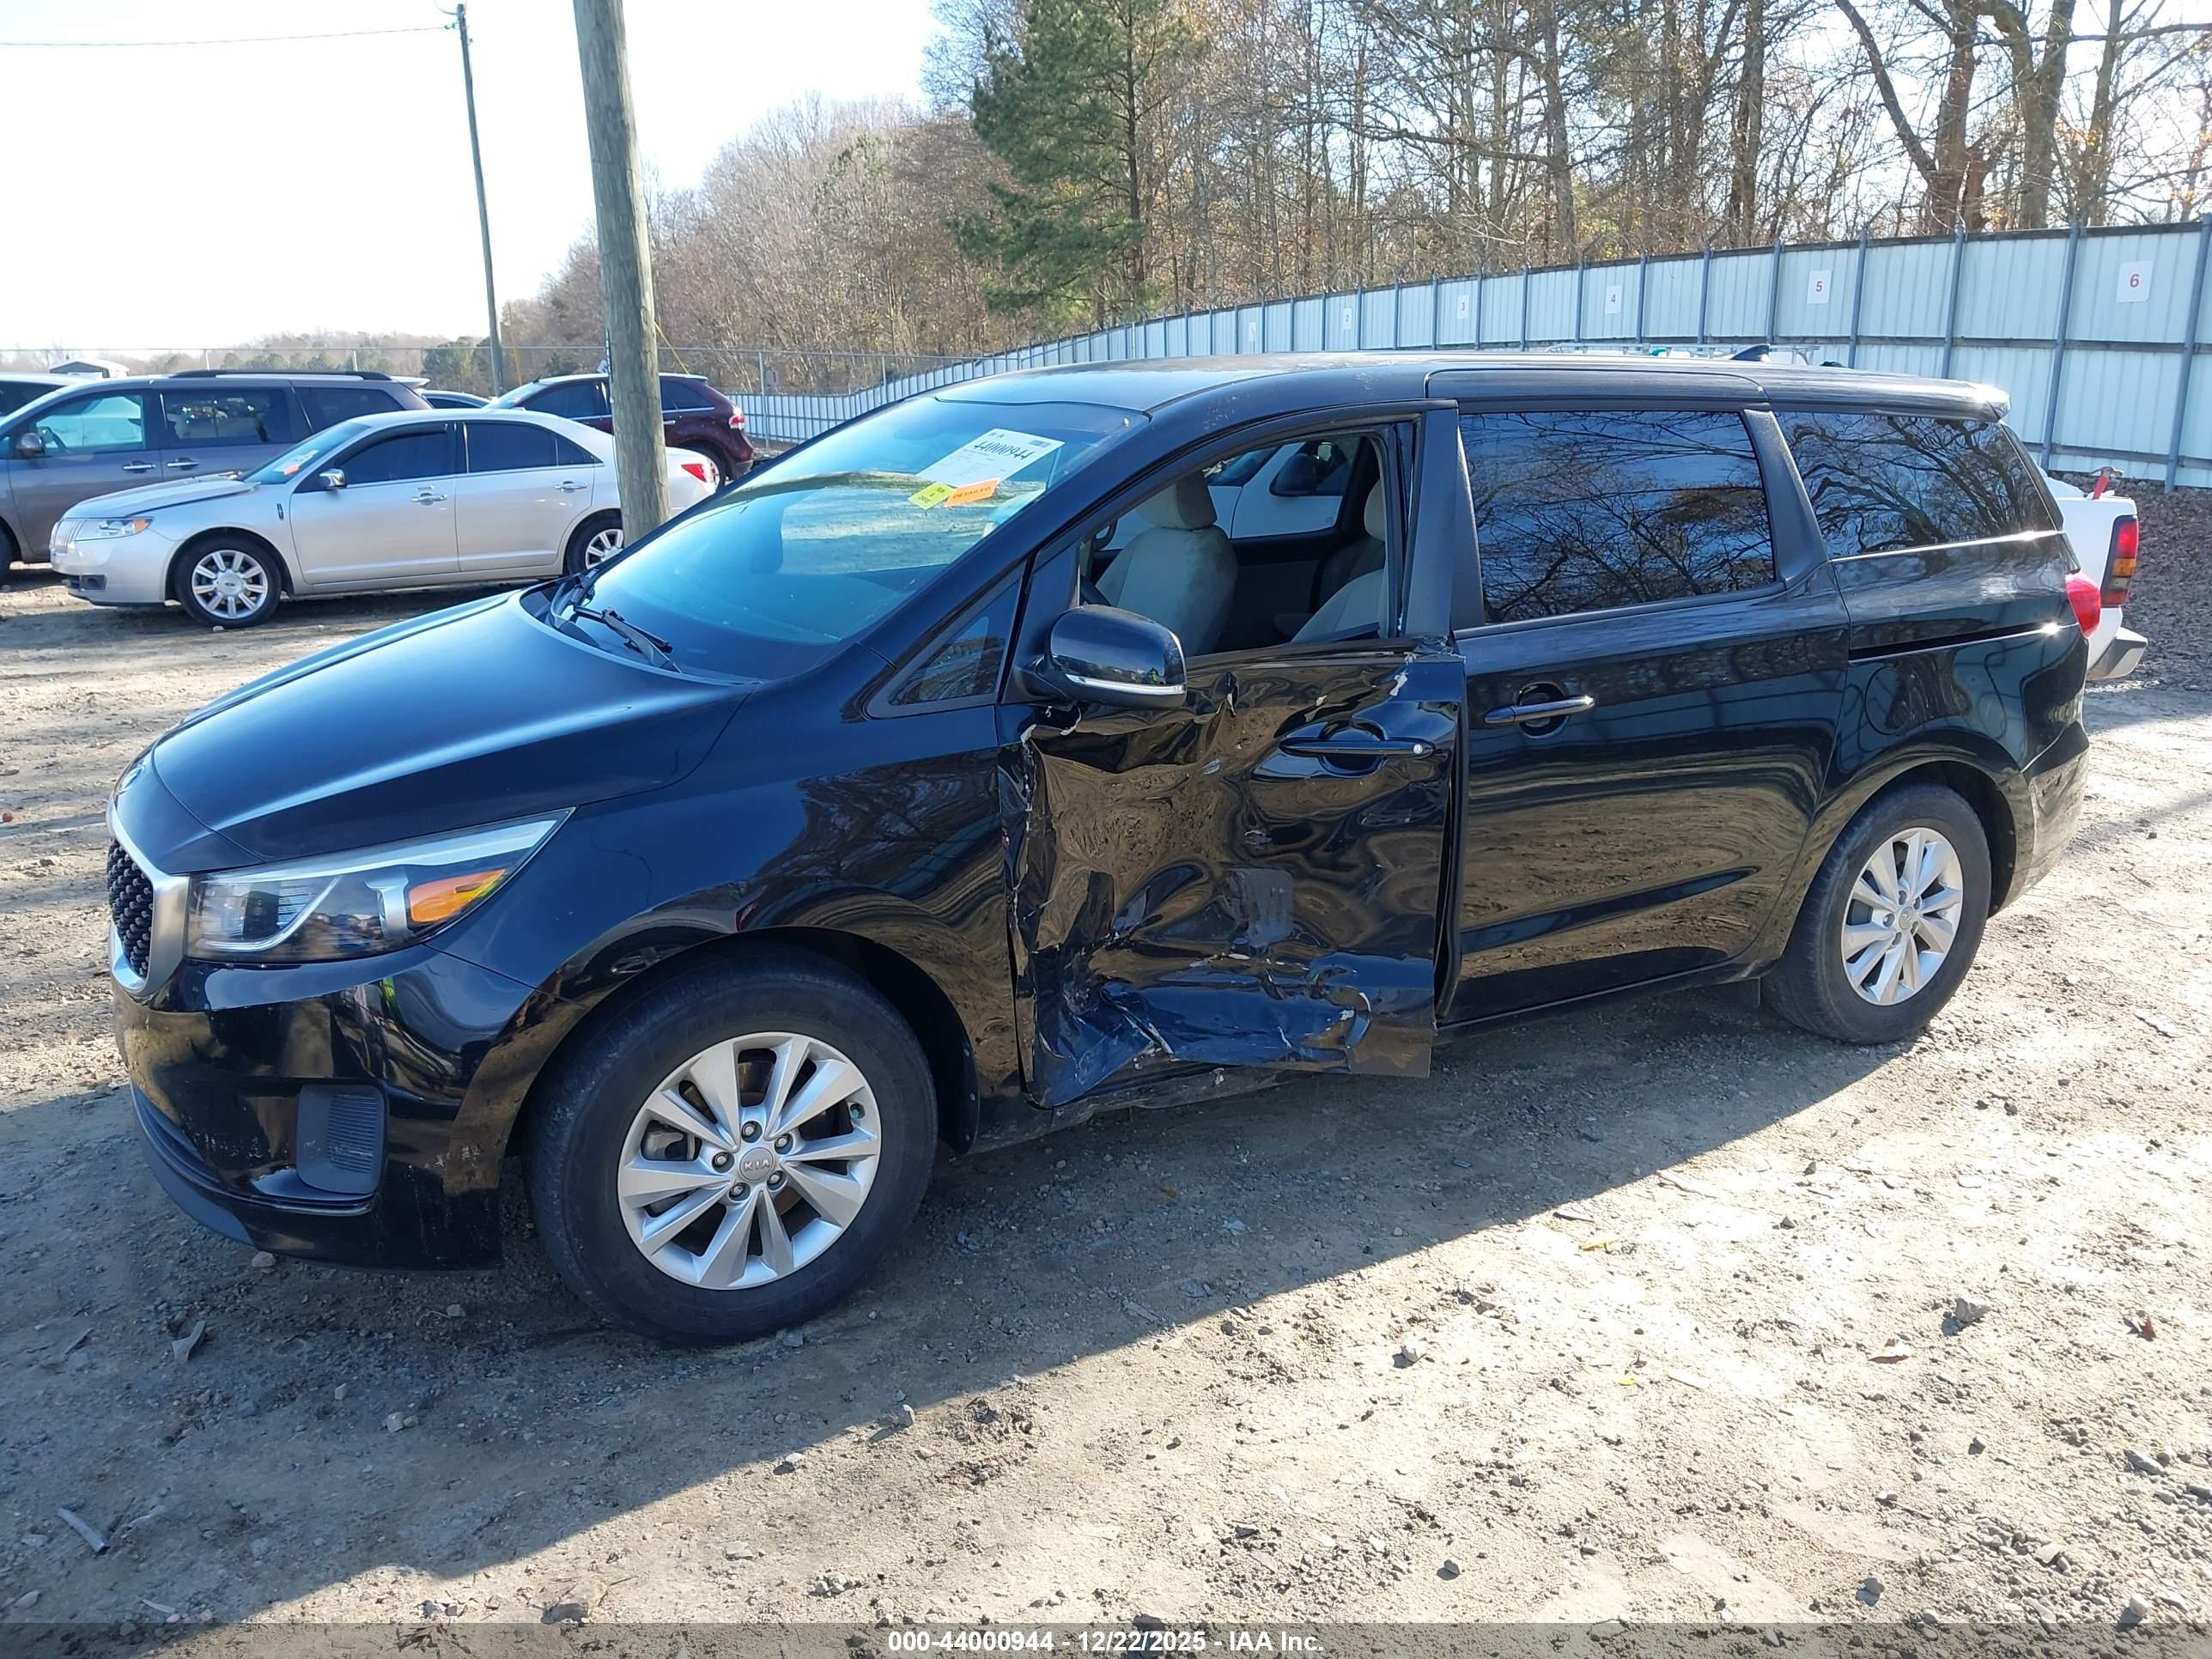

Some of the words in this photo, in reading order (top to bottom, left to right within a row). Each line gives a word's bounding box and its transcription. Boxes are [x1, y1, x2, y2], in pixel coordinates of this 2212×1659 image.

[1815, 281, 1823, 292] 5
[2130, 273, 2140, 288] 6
[1610, 294, 1616, 304] 4
[974, 441, 1036, 459] 44000944
[744, 1158, 770, 1171] KIA
